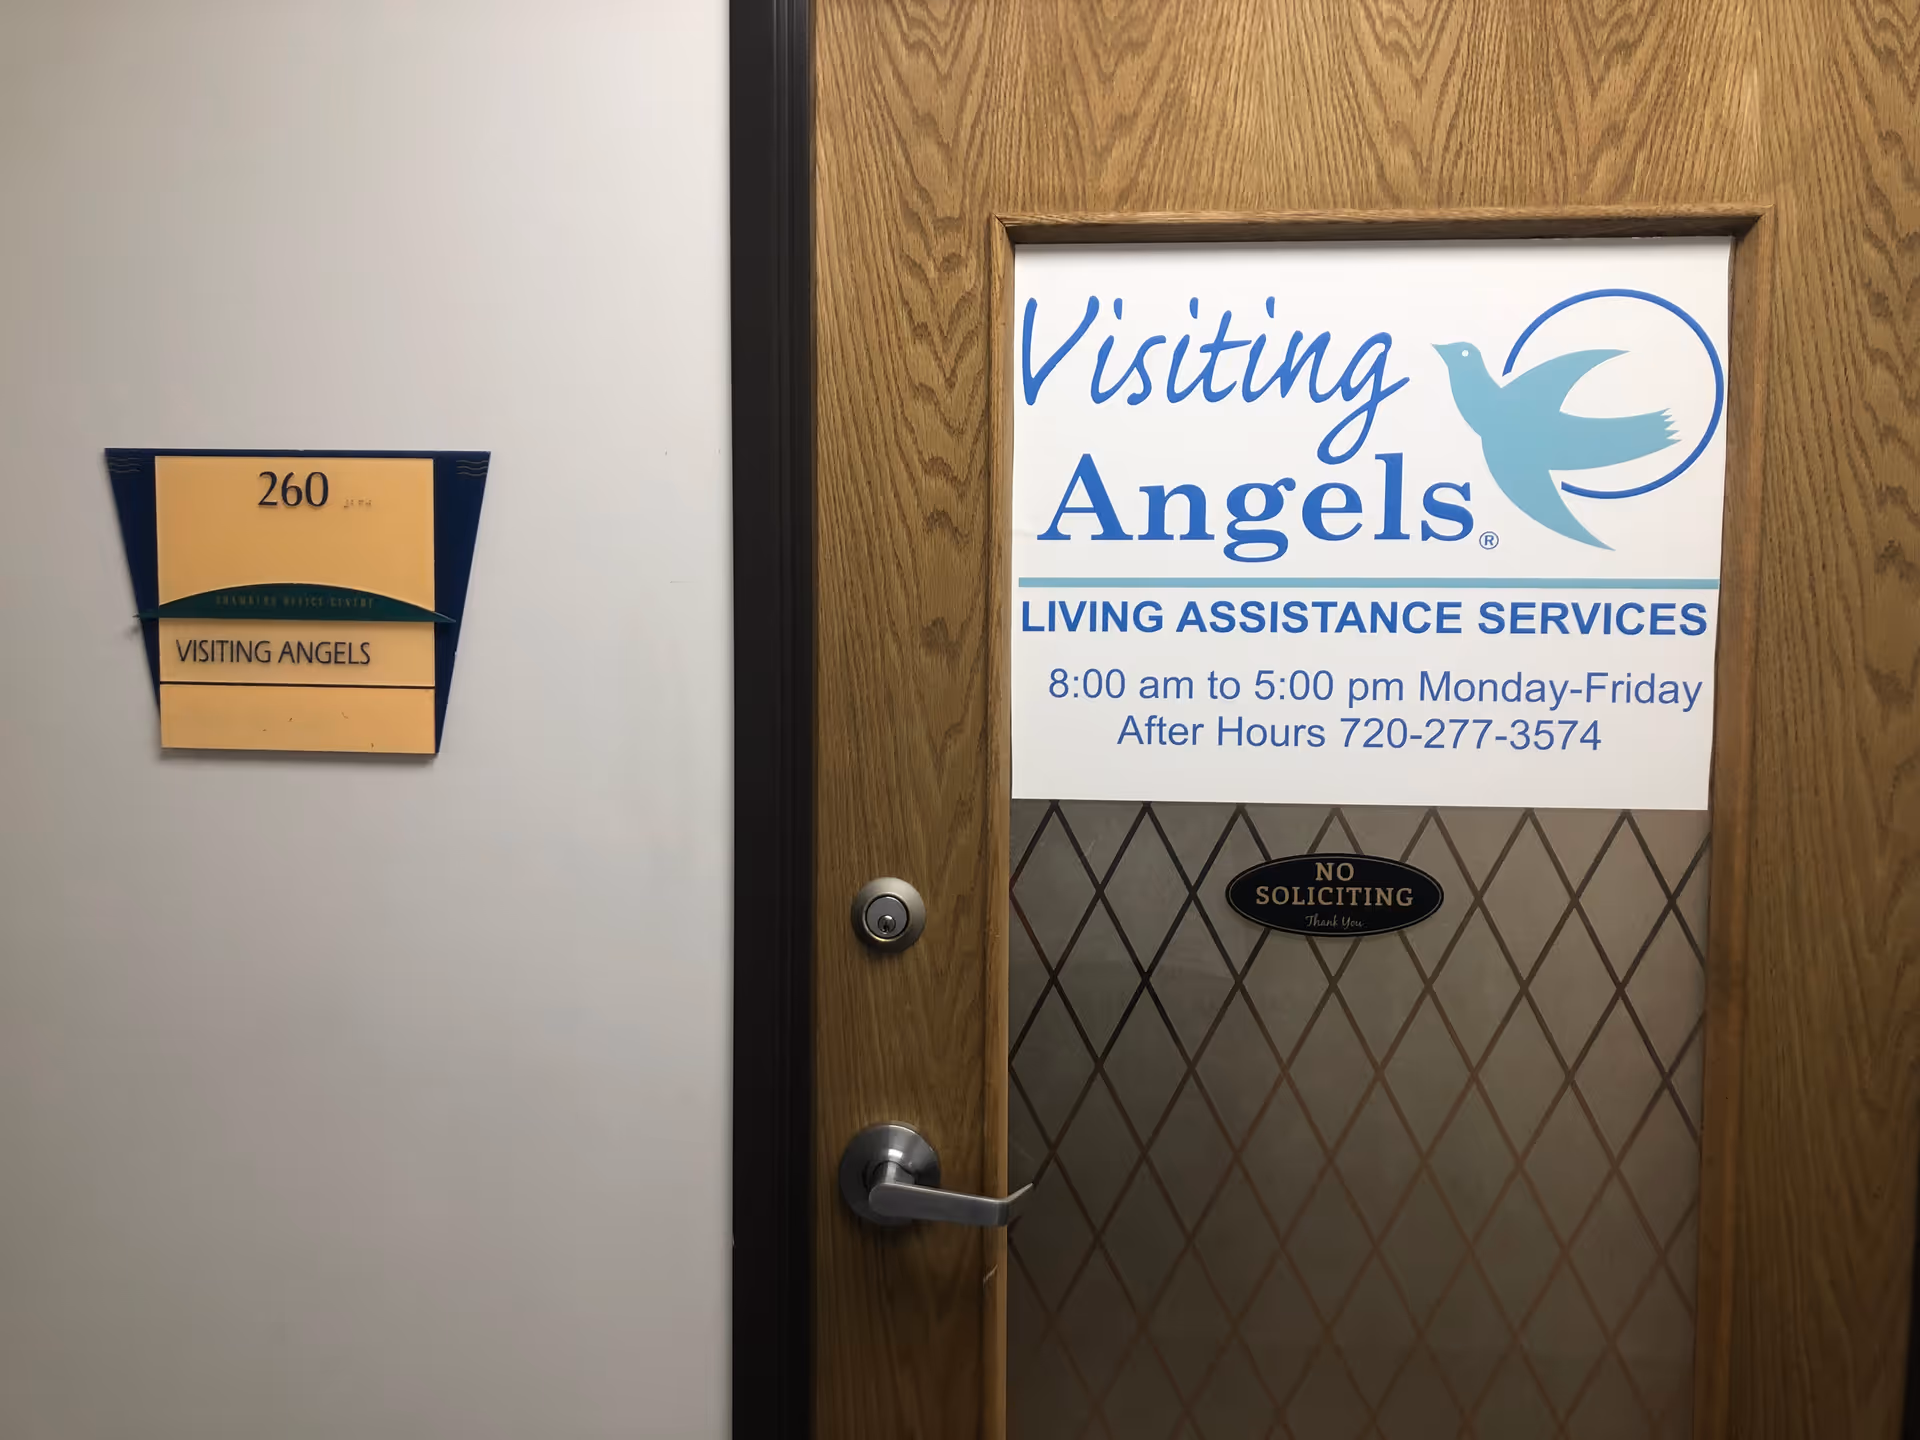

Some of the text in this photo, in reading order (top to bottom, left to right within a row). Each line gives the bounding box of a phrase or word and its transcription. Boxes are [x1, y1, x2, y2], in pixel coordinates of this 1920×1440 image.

[1022, 295, 1410, 464] Visiting
[257, 471, 329, 507] 260
[1036, 452, 1475, 563] Angels
[1021, 599, 1708, 637] LIVING ASSISTANCE SERVICES
[175, 639, 371, 665] VISITING ANGELS
[1049, 668, 1704, 713] 8:00 am to 5:00 pm Monday-Friday
[1117, 715, 1602, 751] After Hours 720-277-3574
[1315, 862, 1355, 882] NO
[1256, 886, 1414, 907] SOLICITING
[1305, 914, 1364, 930] Thank You
